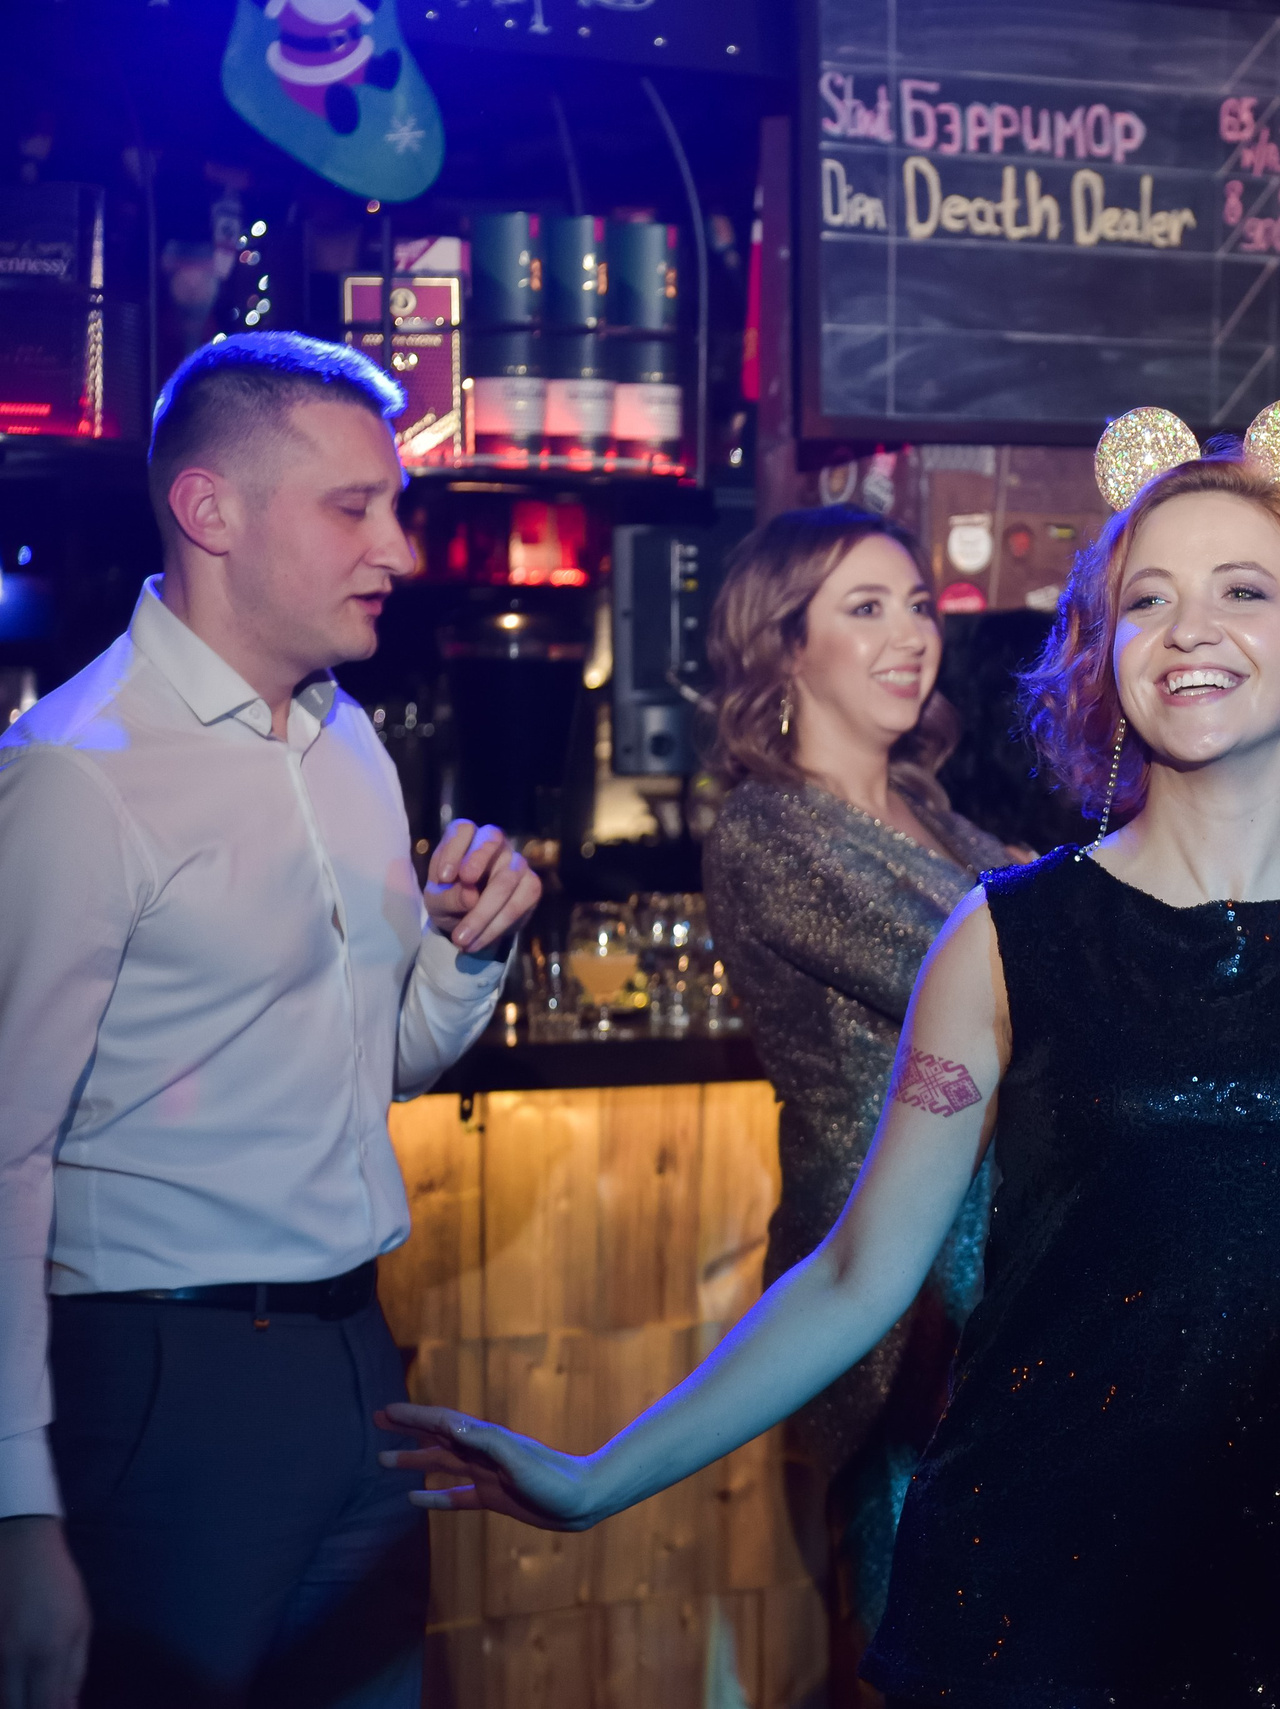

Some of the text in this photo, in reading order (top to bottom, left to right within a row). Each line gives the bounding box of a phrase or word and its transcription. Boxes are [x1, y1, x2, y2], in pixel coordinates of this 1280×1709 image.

[902, 155, 1197, 248] Death Dealer
[0, 257, 71, 276] ennessy
